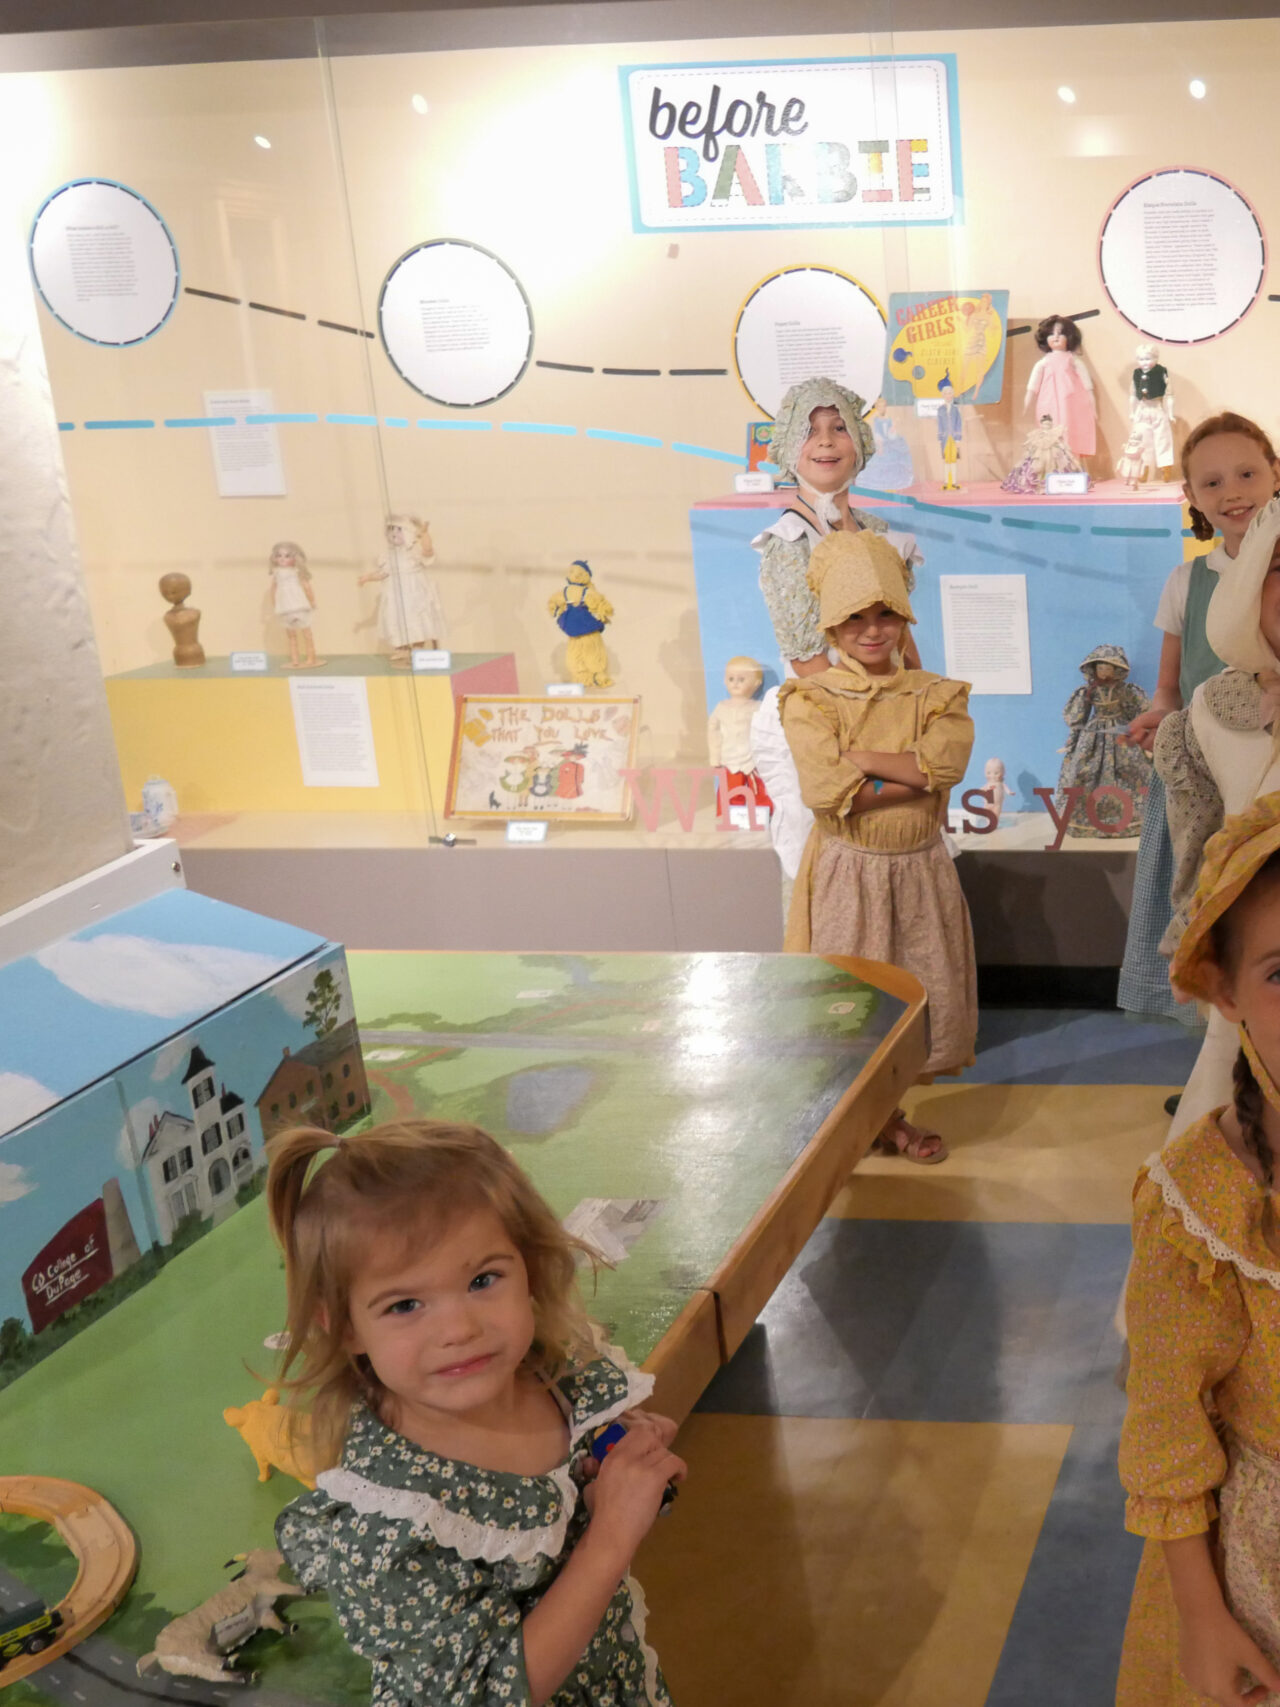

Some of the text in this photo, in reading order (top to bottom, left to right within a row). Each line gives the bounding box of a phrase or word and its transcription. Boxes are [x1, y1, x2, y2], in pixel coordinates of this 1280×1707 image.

[649, 84, 809, 163] before
[896, 295, 960, 327] CAREER
[906, 315, 956, 345] GIRLS
[498, 705, 601, 726] THE DOLLS
[491, 724, 614, 743] THAT YOU LOVE
